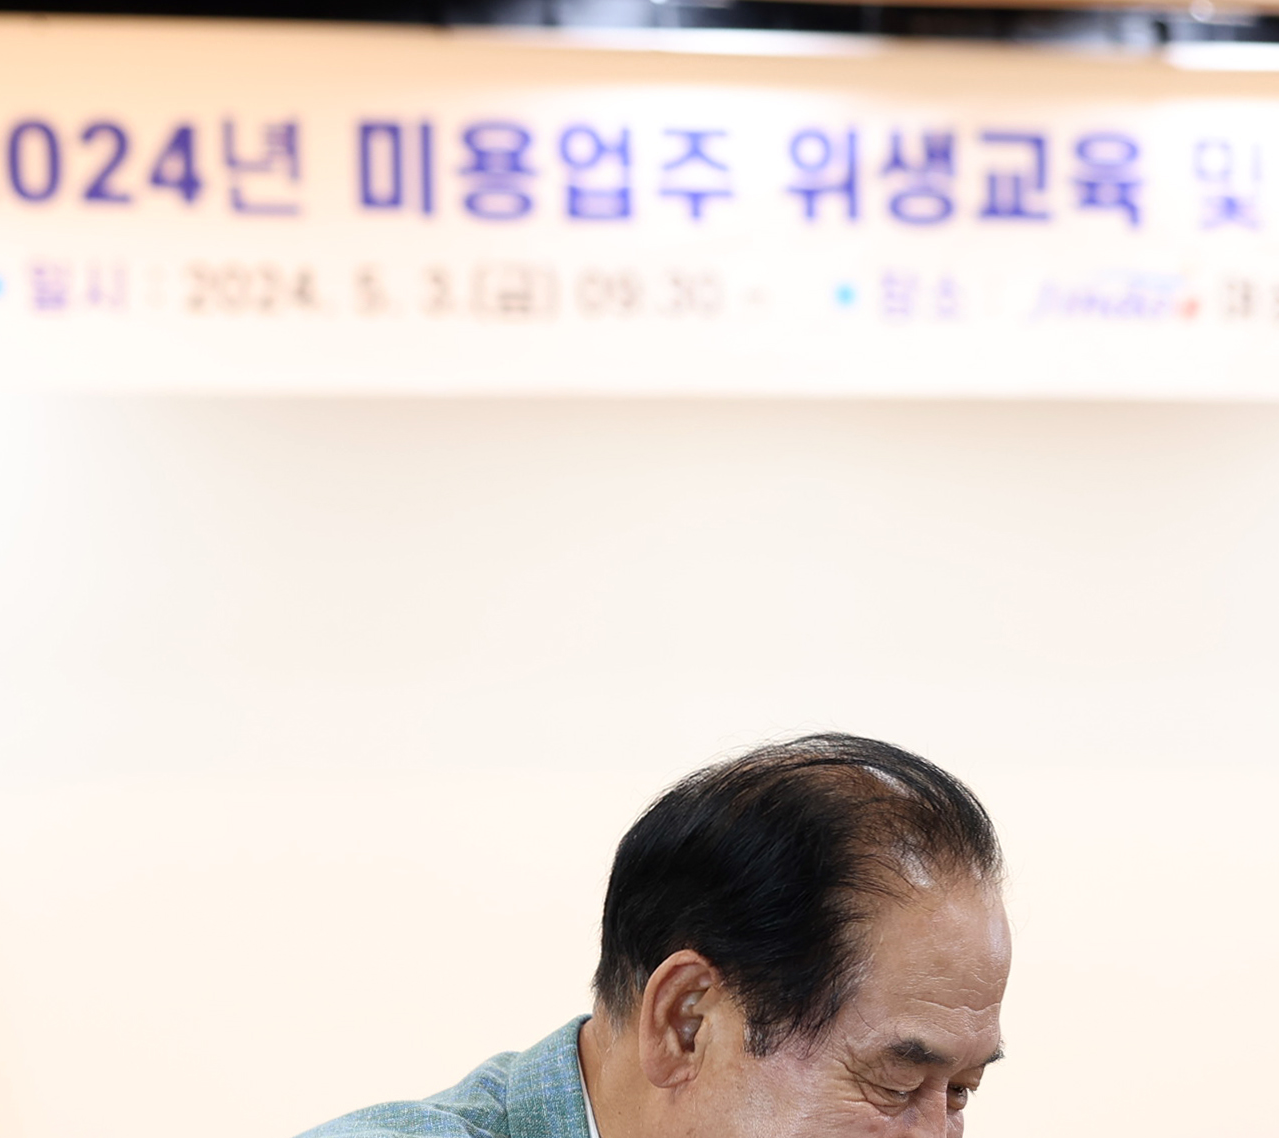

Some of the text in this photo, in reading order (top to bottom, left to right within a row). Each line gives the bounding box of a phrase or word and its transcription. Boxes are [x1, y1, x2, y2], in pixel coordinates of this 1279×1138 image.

[353, 116, 734, 224] 미용업주
[784, 126, 1145, 229] 위생교육
[1191, 138, 1266, 230] 및
